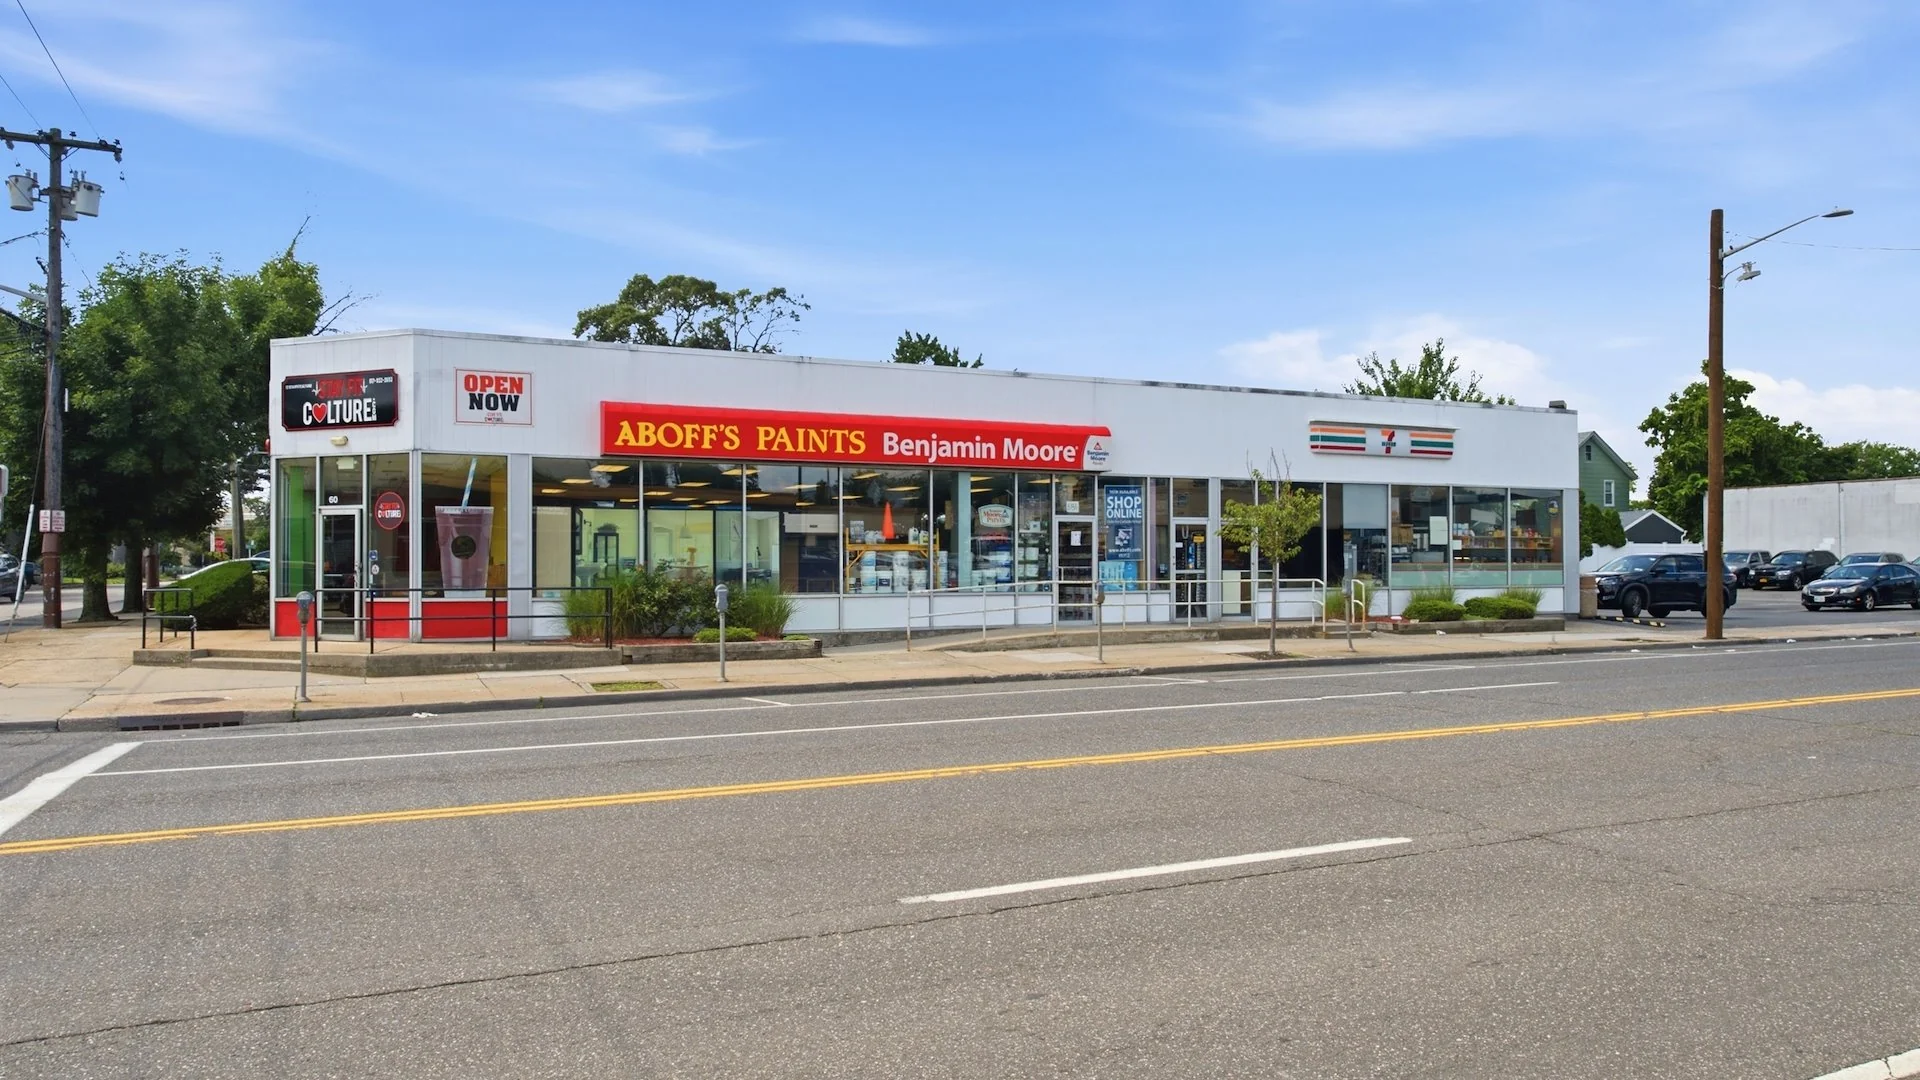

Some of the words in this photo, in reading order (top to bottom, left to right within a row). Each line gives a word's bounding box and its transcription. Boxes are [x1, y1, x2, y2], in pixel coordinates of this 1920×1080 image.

[464, 374, 524, 394] OPEN
[469, 393, 520, 412] NOW
[614, 420, 741, 450] ABOFF'S
[756, 426, 866, 455] PAINTS
[883, 432, 996, 463] Benjamin
[328, 495, 339, 504] 60
[1107, 496, 1142, 509] SHOP
[1106, 508, 1142, 518] ONLINE
